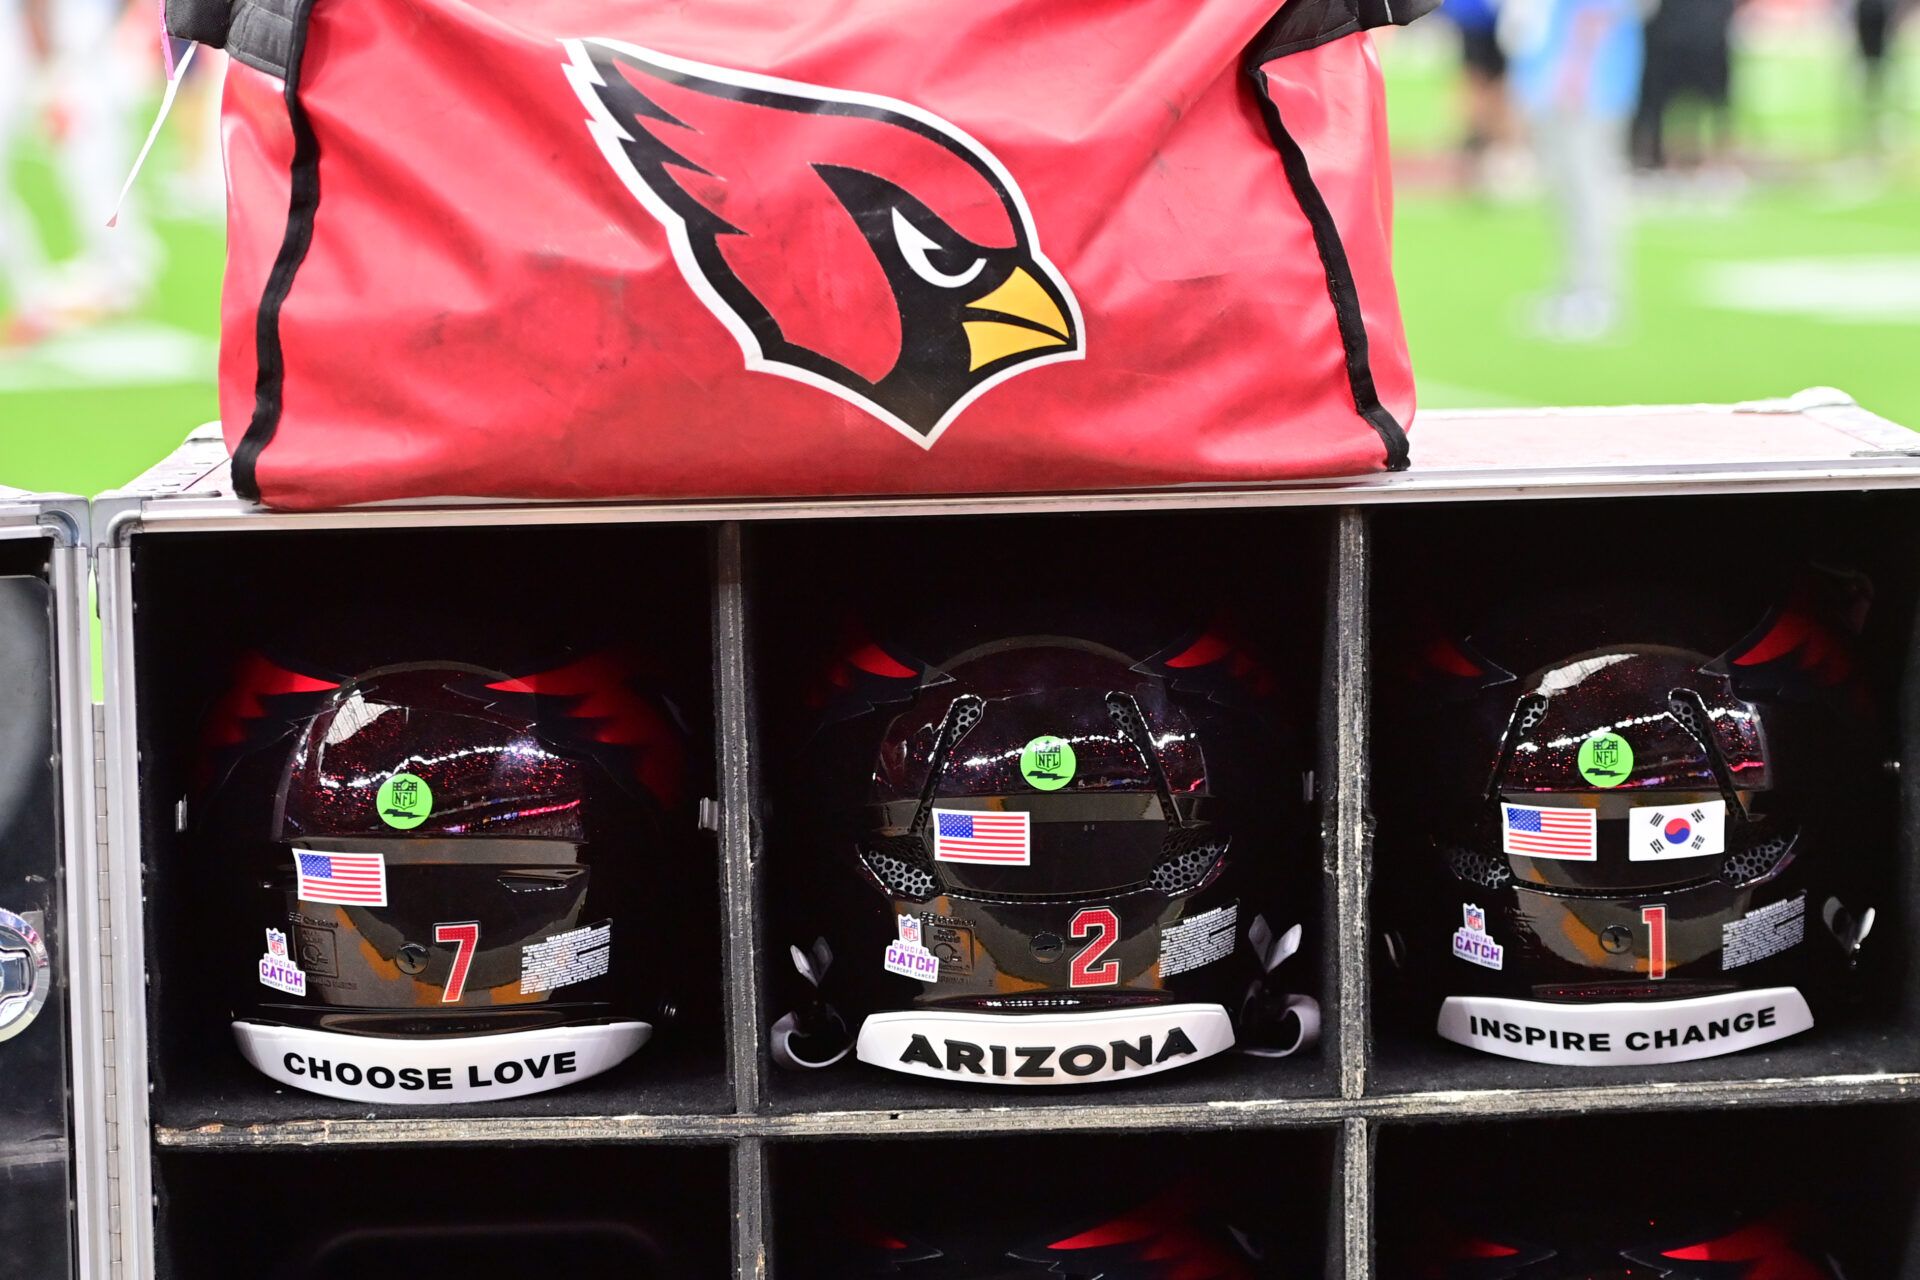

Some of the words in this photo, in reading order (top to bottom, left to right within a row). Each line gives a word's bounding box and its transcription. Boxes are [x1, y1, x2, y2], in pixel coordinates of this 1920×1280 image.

[1038, 753, 1059, 768] NFL
[1596, 750, 1616, 766] NFL
[394, 791, 415, 807] NFL
[1183, 907, 1222, 925] WARNING
[1745, 898, 1788, 919] WARNING
[1467, 916, 1482, 930] NFL
[546, 926, 592, 942] WARNING
[902, 926, 918, 940] NFL
[1460, 929, 1493, 946] CRUCIAL
[271, 940, 285, 954] NFL
[894, 942, 929, 957] CRUCIAL
[1069, 907, 1119, 988] 2
[1455, 935, 1500, 962] CATCH
[1641, 906, 1666, 980] 1
[265, 955, 296, 971] CRUCIAL
[434, 923, 480, 1003] 7
[888, 948, 936, 974] CATCH
[261, 962, 303, 987] CATCH
[914, 971, 935, 980] CANCER
[1470, 1015, 1612, 1052] INSPIRE
[1625, 1006, 1776, 1051] CHANGE
[899, 1026, 1198, 1078] ARIZONA
[284, 1052, 453, 1090] CHOOSE
[468, 1051, 577, 1088] LOVE
